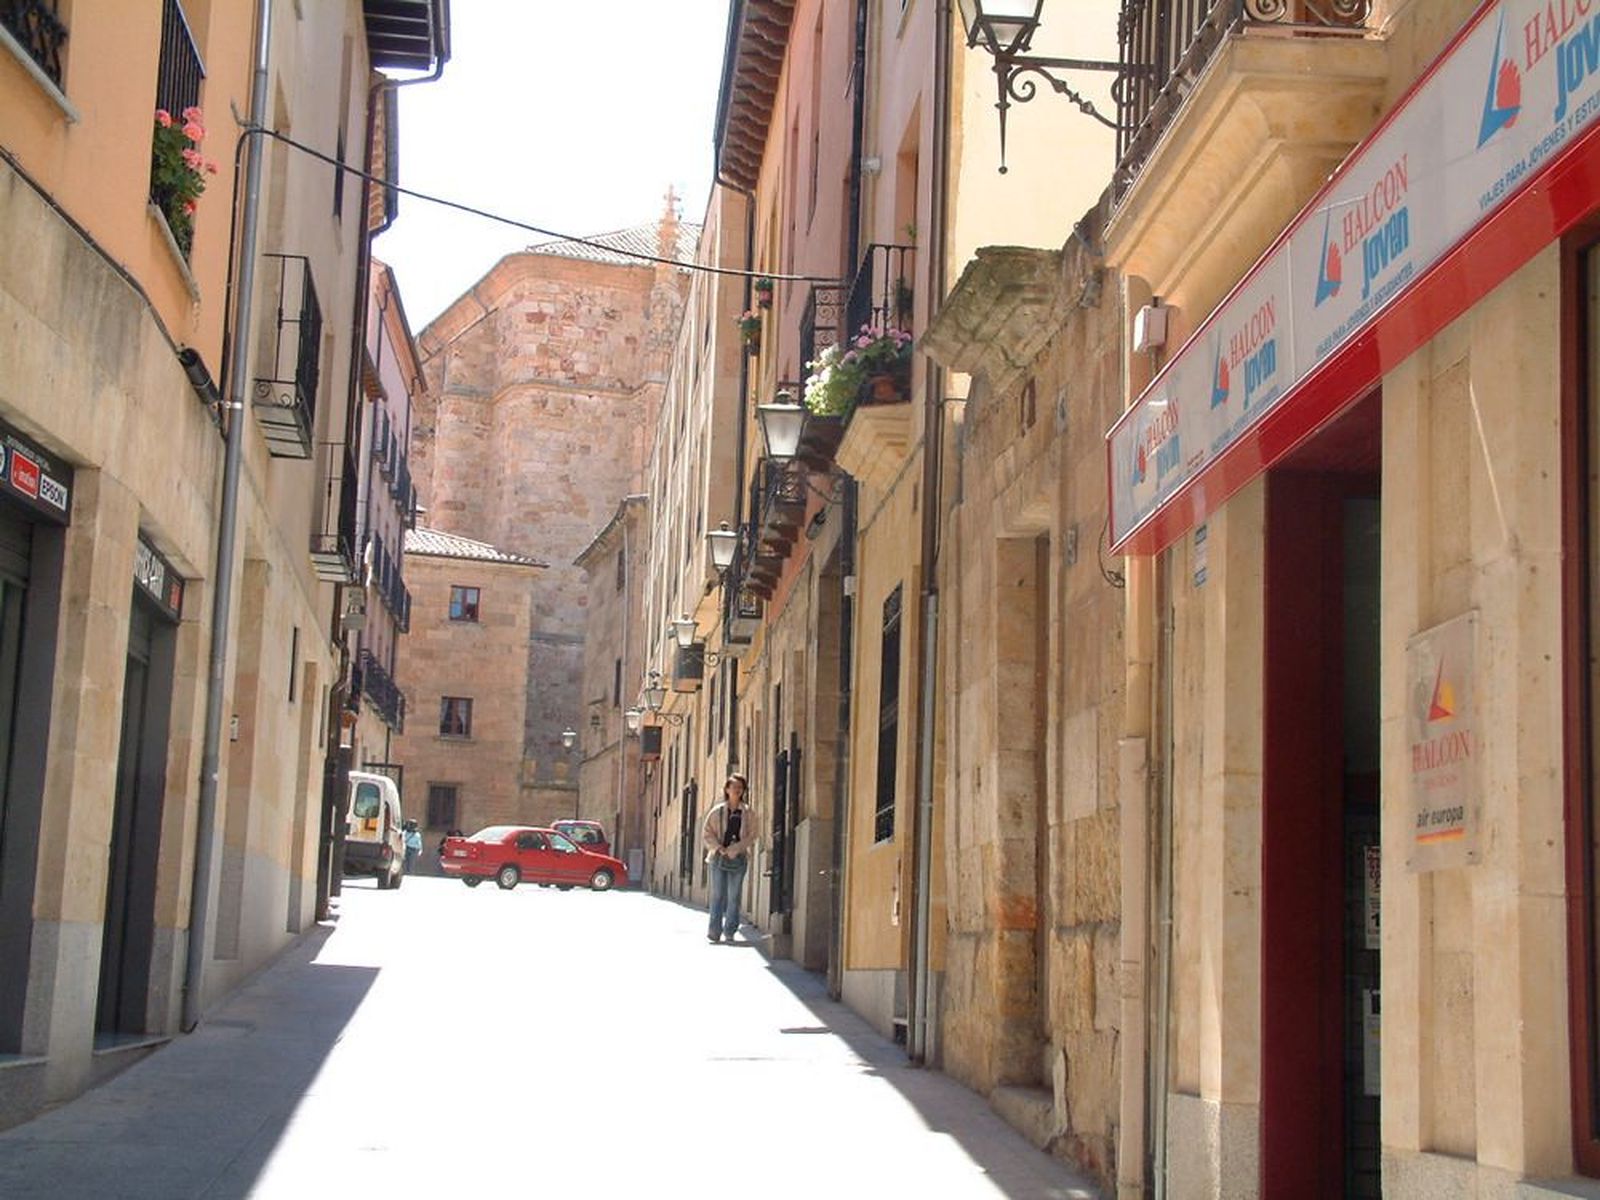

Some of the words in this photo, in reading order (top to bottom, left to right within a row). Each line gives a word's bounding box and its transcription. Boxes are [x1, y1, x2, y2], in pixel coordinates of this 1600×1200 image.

[1479, 178, 1505, 210] VIAJES
[1506, 159, 1527, 185] PARA
[1528, 122, 1566, 168] JOVENES
[1567, 114, 1574, 131] Y
[1343, 152, 1408, 255] HALCON
[1230, 294, 1275, 370] HALCON
[42, 479, 65, 508] EPSON
[1411, 728, 1471, 773] HALCON
[1416, 807, 1429, 828] air
[1431, 805, 1463, 827] europa
